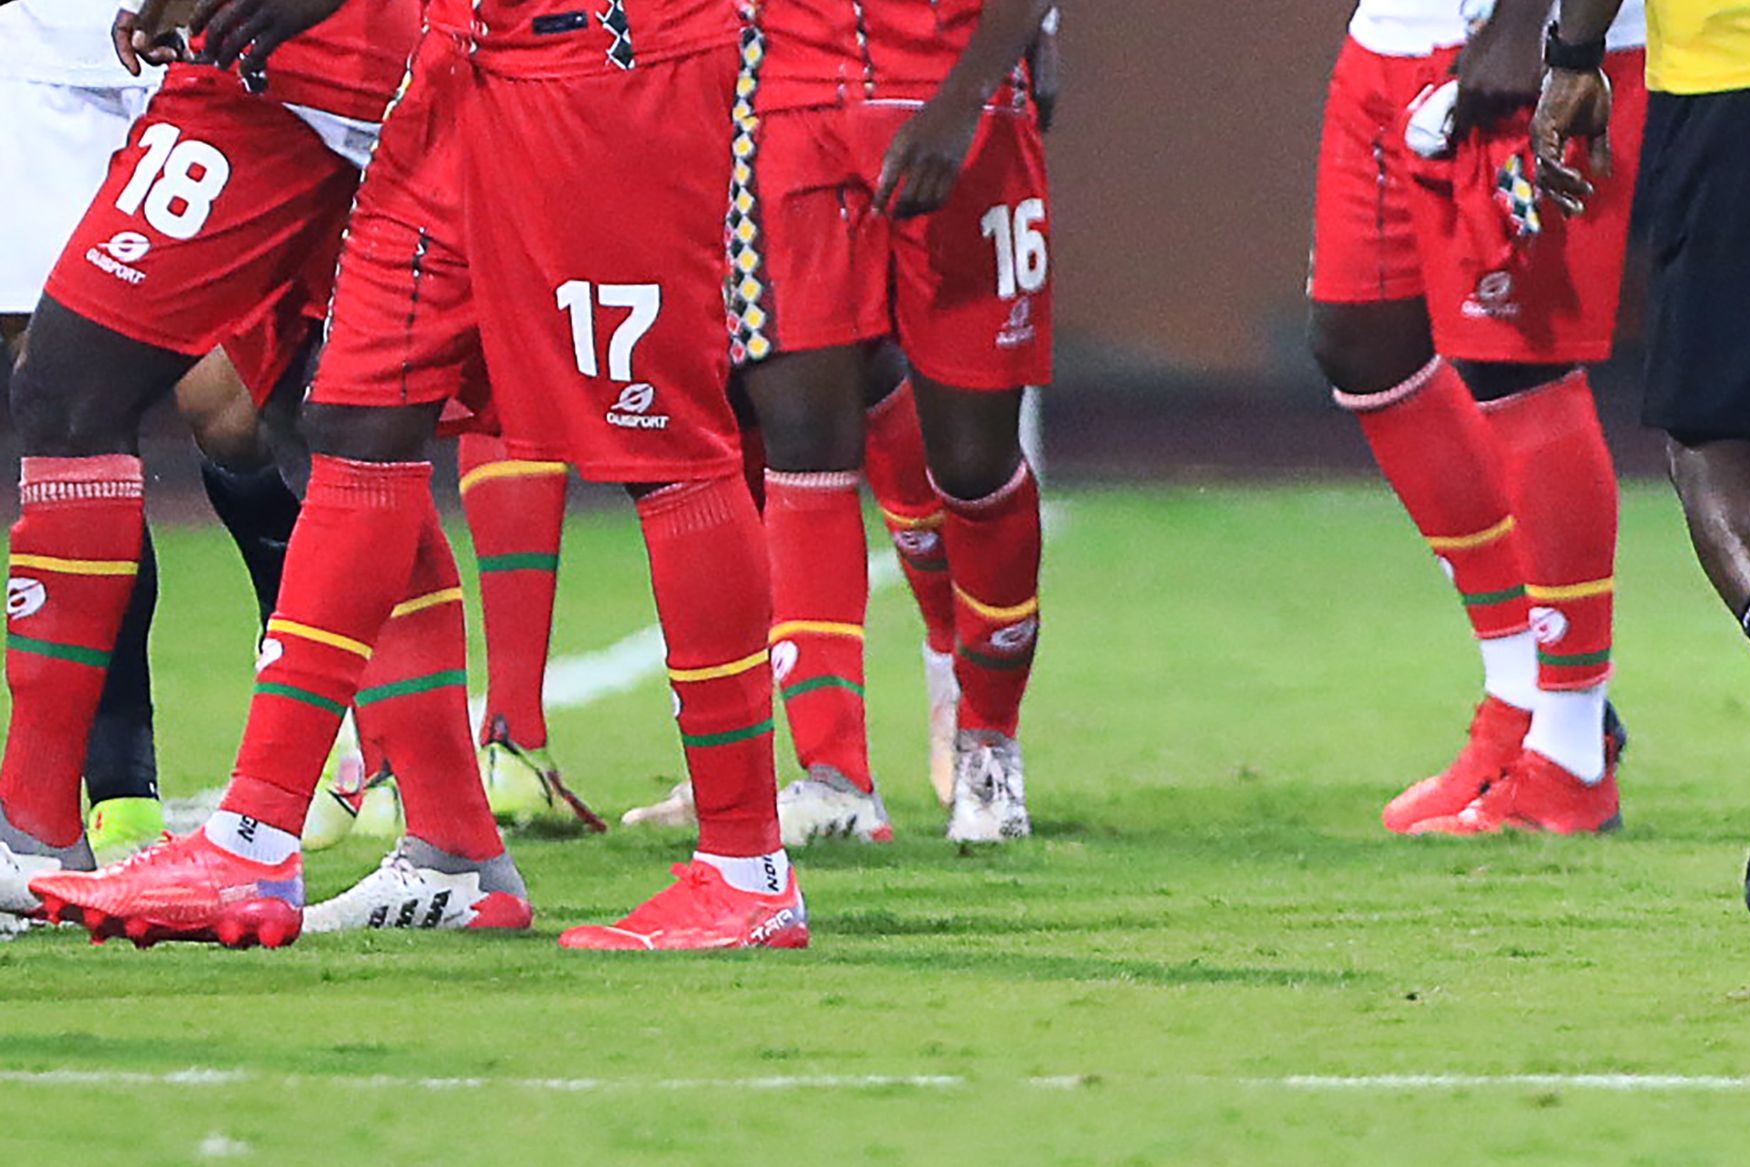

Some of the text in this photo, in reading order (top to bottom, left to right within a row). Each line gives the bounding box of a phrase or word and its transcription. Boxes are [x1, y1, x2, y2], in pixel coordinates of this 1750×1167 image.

[115, 122, 231, 240] 18
[980, 197, 1047, 299] 16
[555, 279, 661, 381] 17
